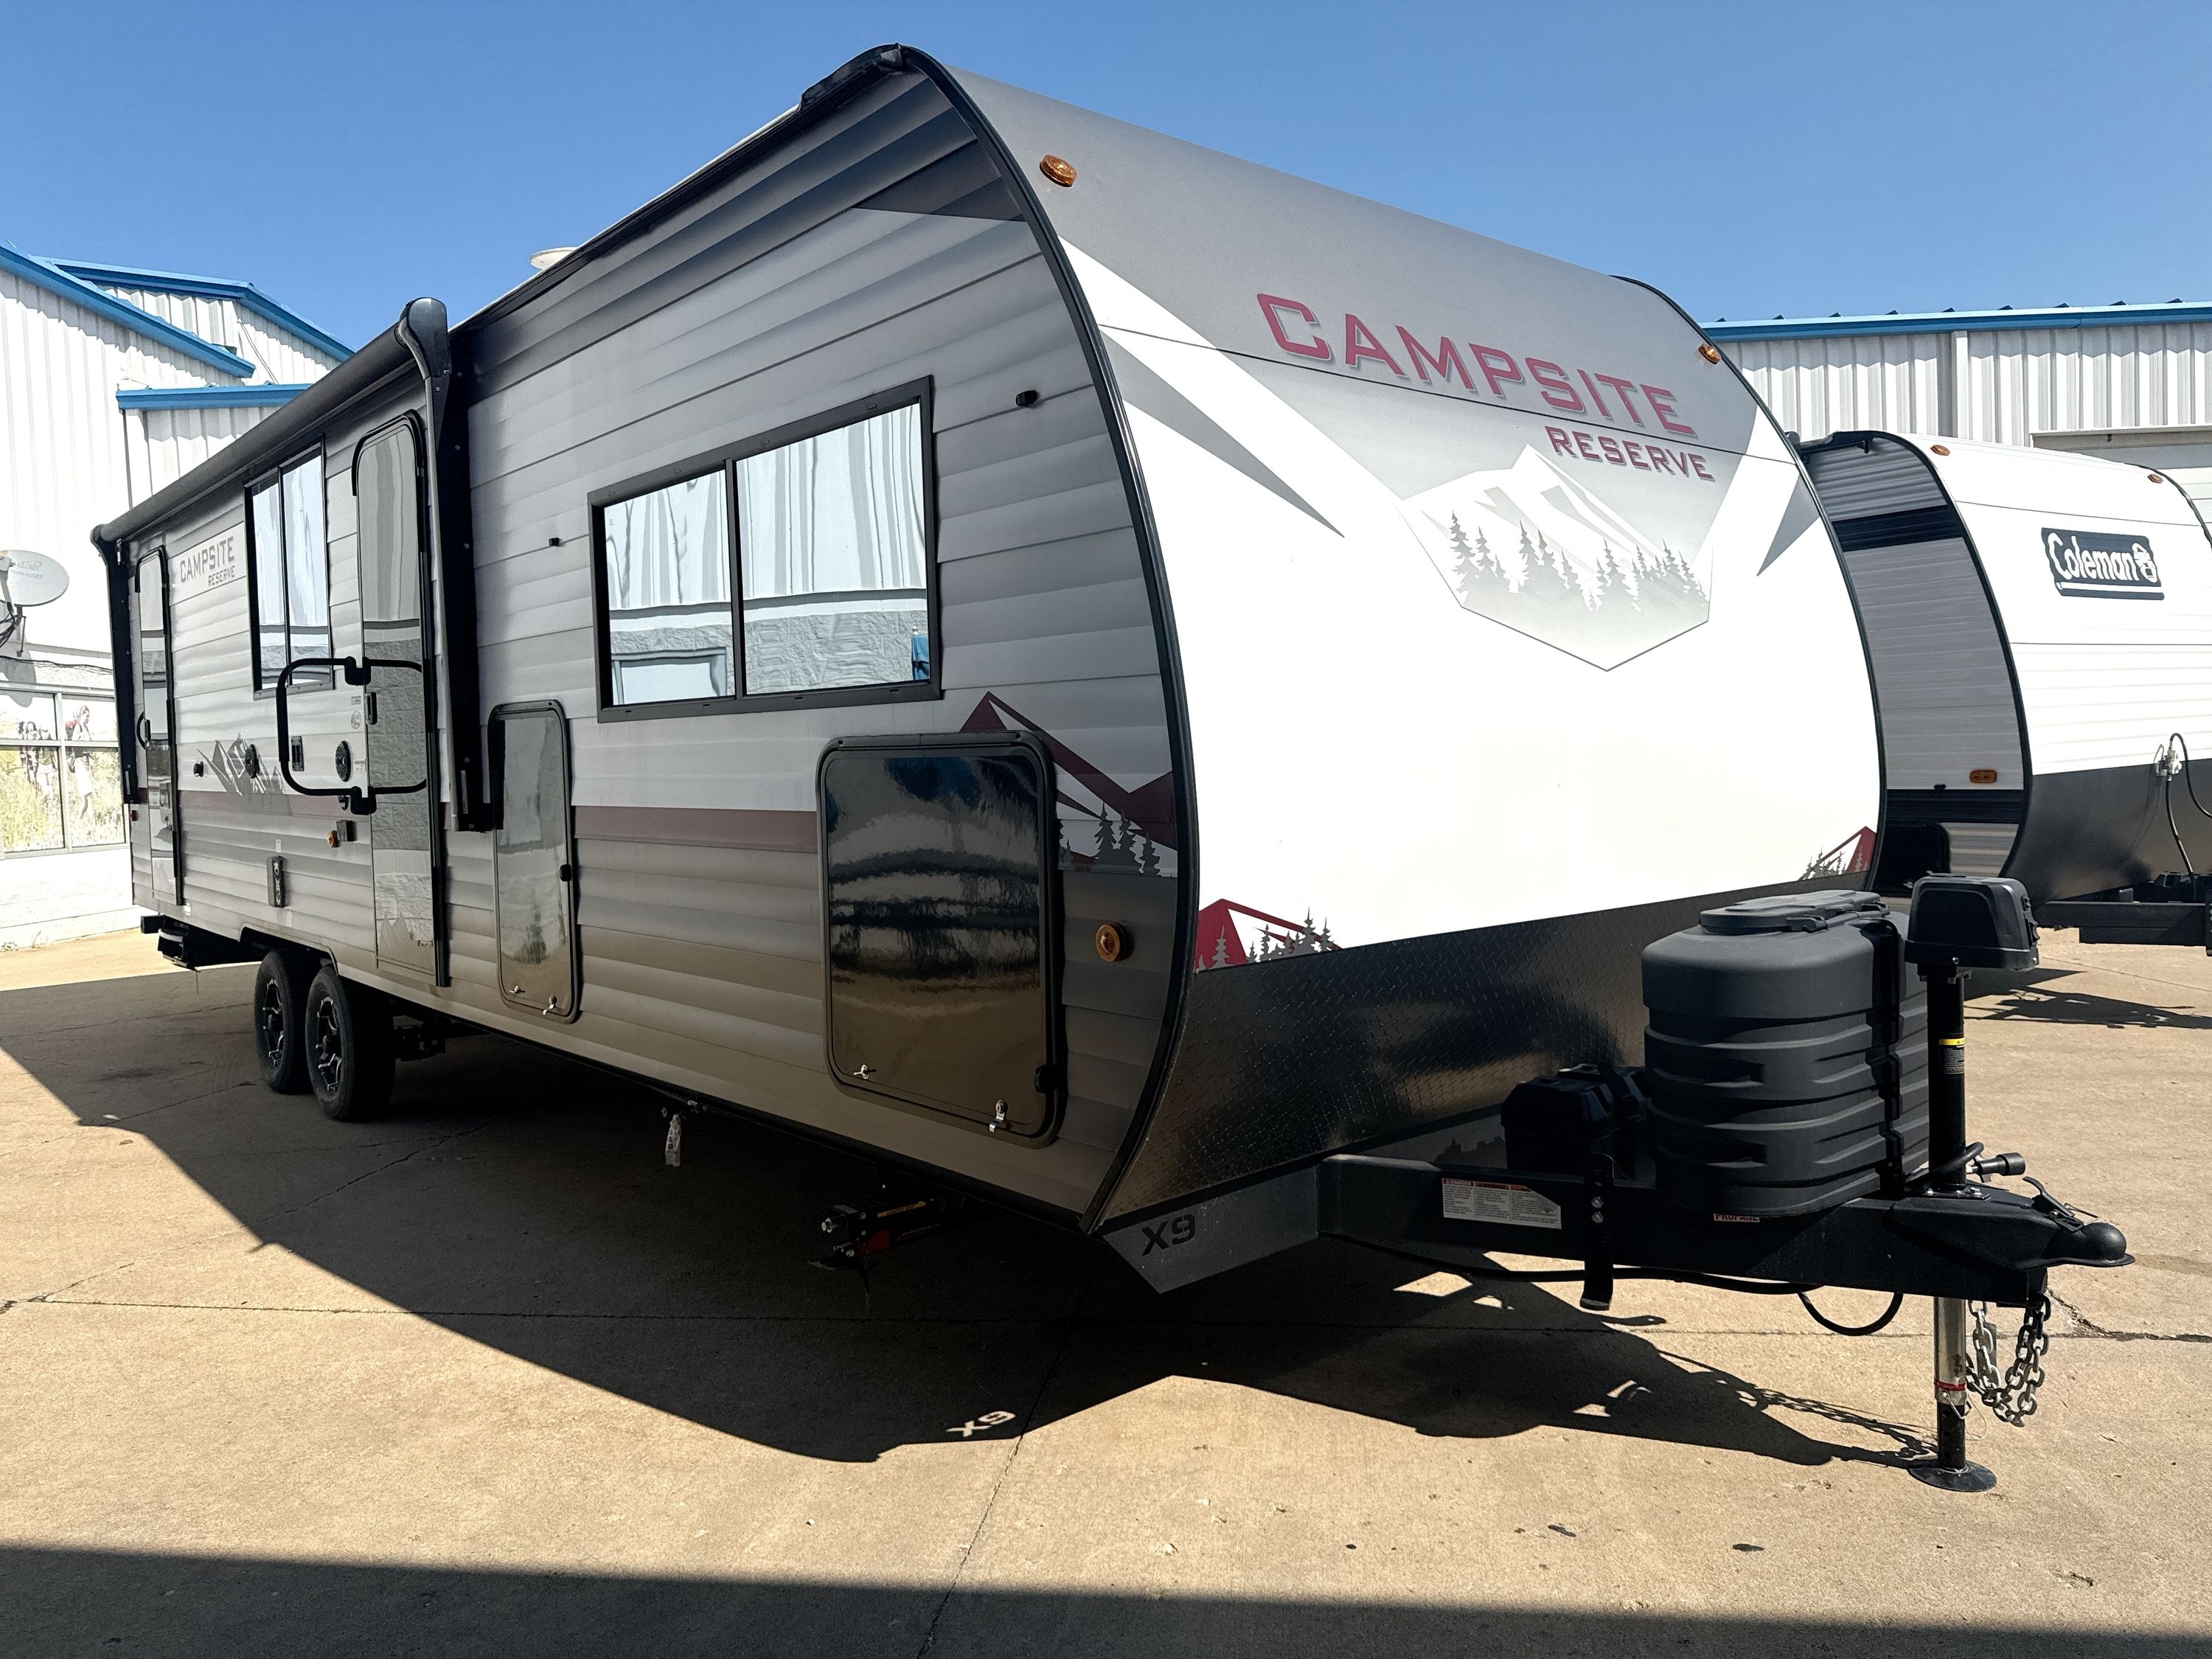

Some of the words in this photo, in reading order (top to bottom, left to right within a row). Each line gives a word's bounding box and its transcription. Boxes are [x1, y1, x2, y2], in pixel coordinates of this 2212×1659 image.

[1256, 293, 1697, 437] CAMPSITE
[1544, 425, 1716, 481] RESERVE
[180, 536, 235, 583] CAMPSITE
[208, 565, 236, 587] RESERVE
[2047, 532, 2140, 582] Coleman
[1141, 1213, 1196, 1256] X9
